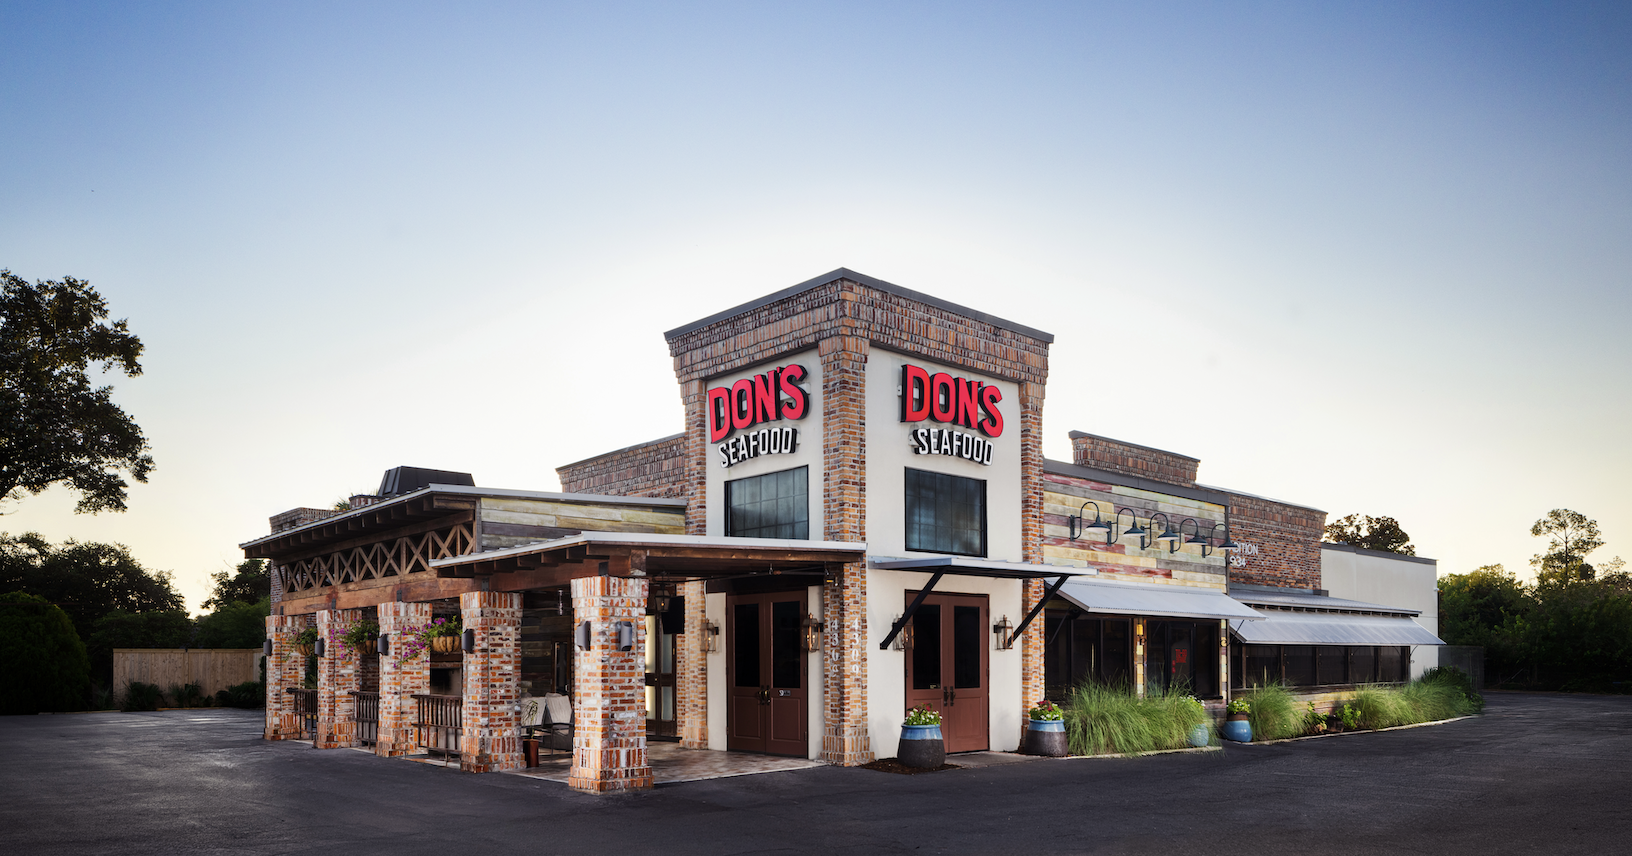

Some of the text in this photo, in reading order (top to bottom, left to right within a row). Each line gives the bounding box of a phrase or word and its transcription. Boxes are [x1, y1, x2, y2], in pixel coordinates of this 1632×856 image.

[708, 364, 809, 444] DON'S
[901, 364, 1004, 437] DON'S
[718, 428, 797, 468] SEAFOOD
[913, 428, 994, 466] SEAFOOD
[851, 617, 860, 675] 4309
